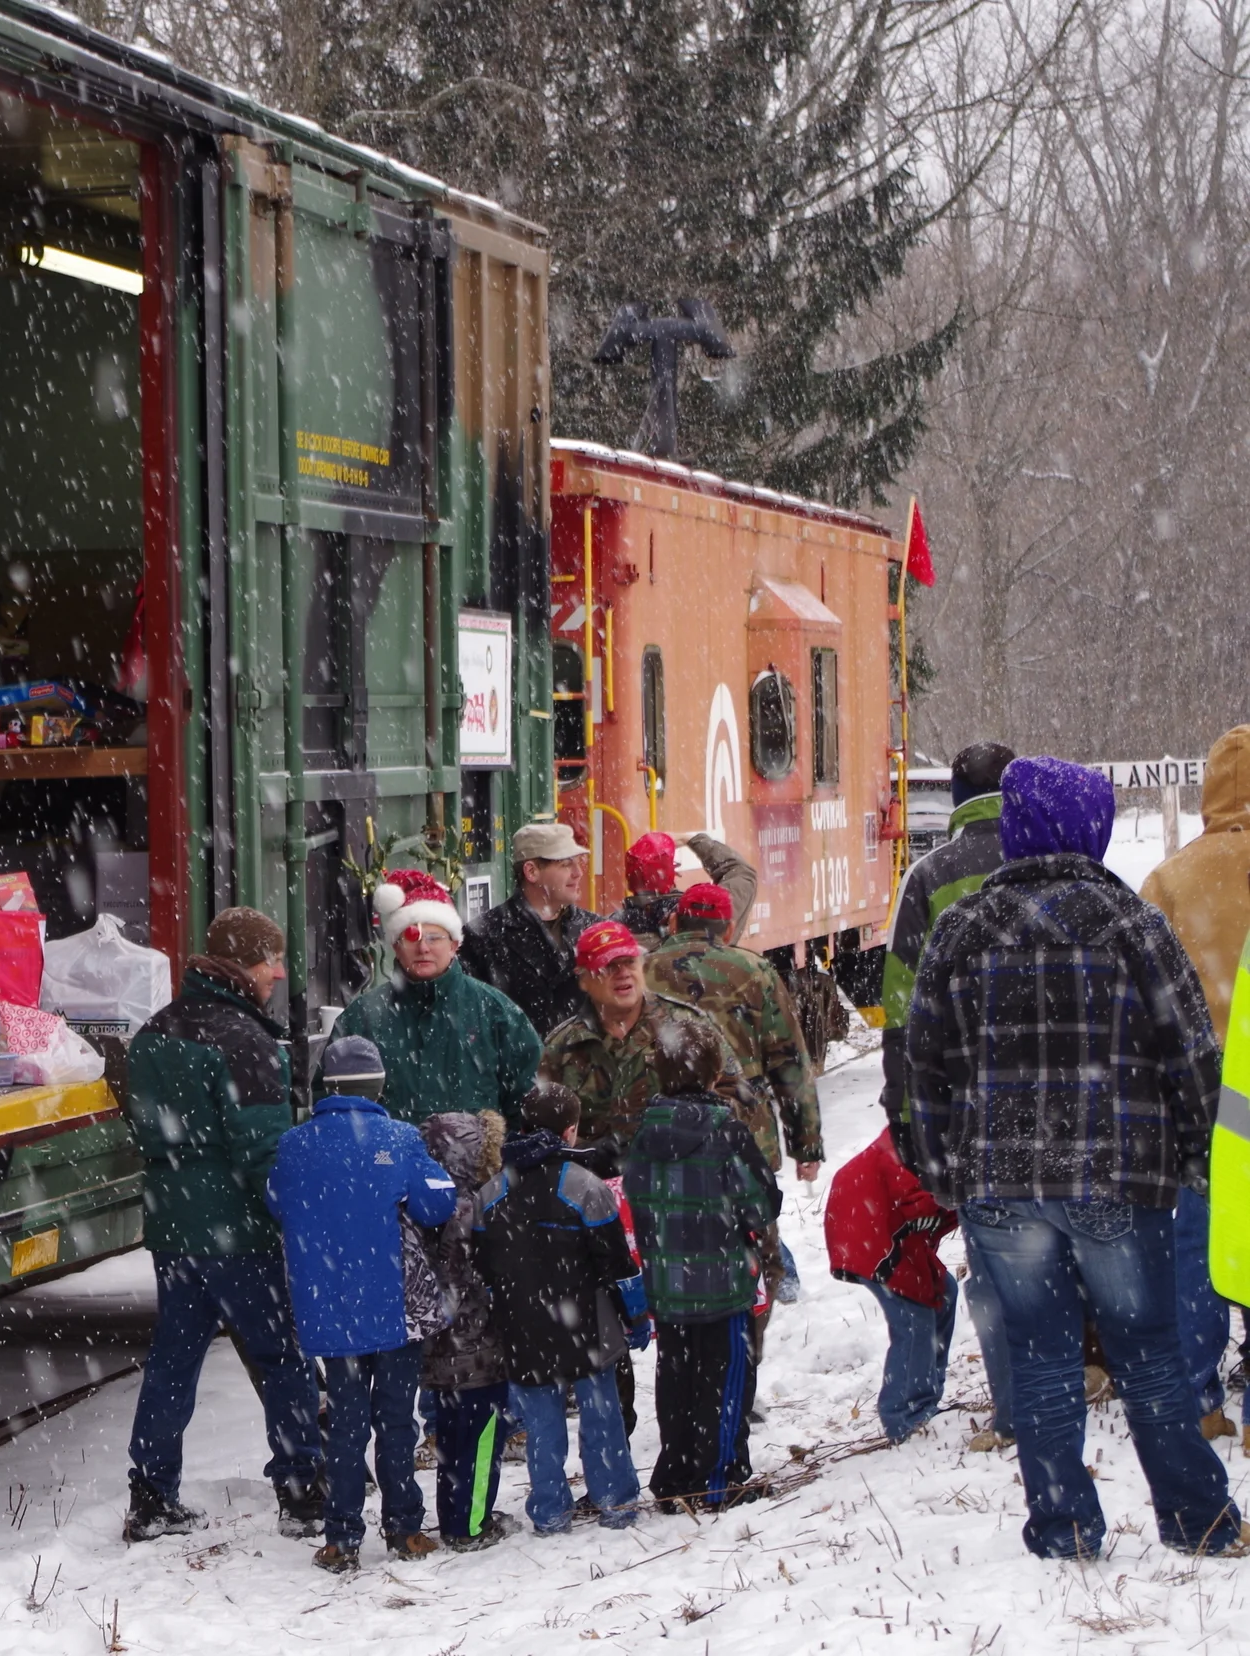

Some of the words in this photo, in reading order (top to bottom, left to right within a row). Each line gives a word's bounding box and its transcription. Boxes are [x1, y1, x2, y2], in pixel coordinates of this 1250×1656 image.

[1096, 762, 1207, 788] LANDE
[812, 856, 850, 912] 21303
[89, 1025, 126, 1034] OUTDOOR
